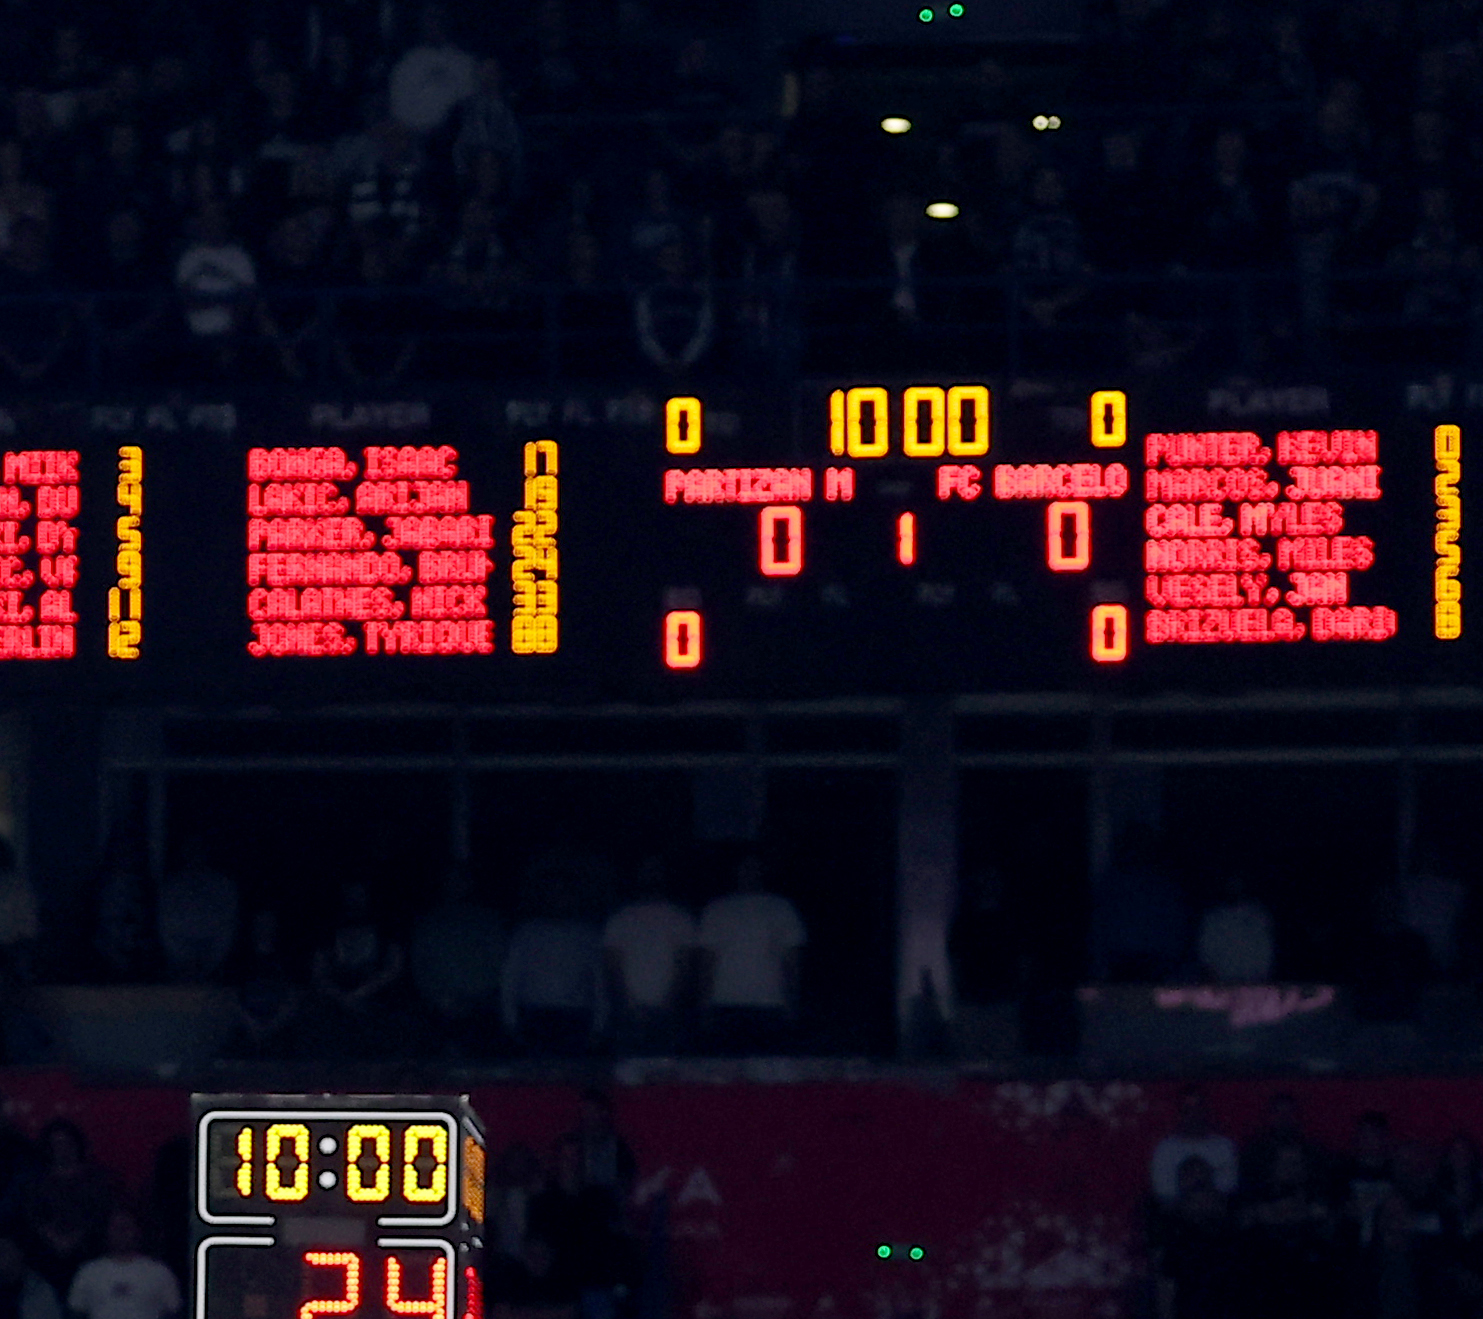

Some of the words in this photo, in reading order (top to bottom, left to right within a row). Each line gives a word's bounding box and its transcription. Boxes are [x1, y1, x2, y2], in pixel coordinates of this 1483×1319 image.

[666, 396, 701, 454] 0
[1091, 390, 1126, 447] 0
[364, 446, 457, 480] ISAAC
[524, 440, 558, 476] 17
[1145, 433, 1272, 467] PUNTER,
[1277, 430, 1378, 465] KEVIN
[1434, 424, 1461, 460] 0
[118, 446, 142, 483] 3
[937, 464, 981, 501] FC
[117, 483, 142, 516] 4
[664, 467, 812, 503] PARTIZAN
[1145, 467, 1278, 501] MARCOS,
[117, 516, 142, 552] 5
[248, 517, 375, 551] PARKER,
[898, 511, 914, 565] 1
[1047, 501, 1090, 571] 0
[1145, 503, 1233, 537] CALE,
[760, 505, 803, 576] 0
[512, 547, 558, 582] 24
[108, 587, 142, 622] 11
[512, 580, 558, 616] 33
[1145, 573, 1279, 607] VESELY,
[1286, 571, 1348, 606] JAN
[512, 616, 558, 653] 88
[665, 610, 700, 668] 0
[1092, 604, 1127, 662] 0
[1434, 601, 1461, 640] 8
[108, 621, 142, 658] 12
[237, 1124, 447, 1200] 10:00
